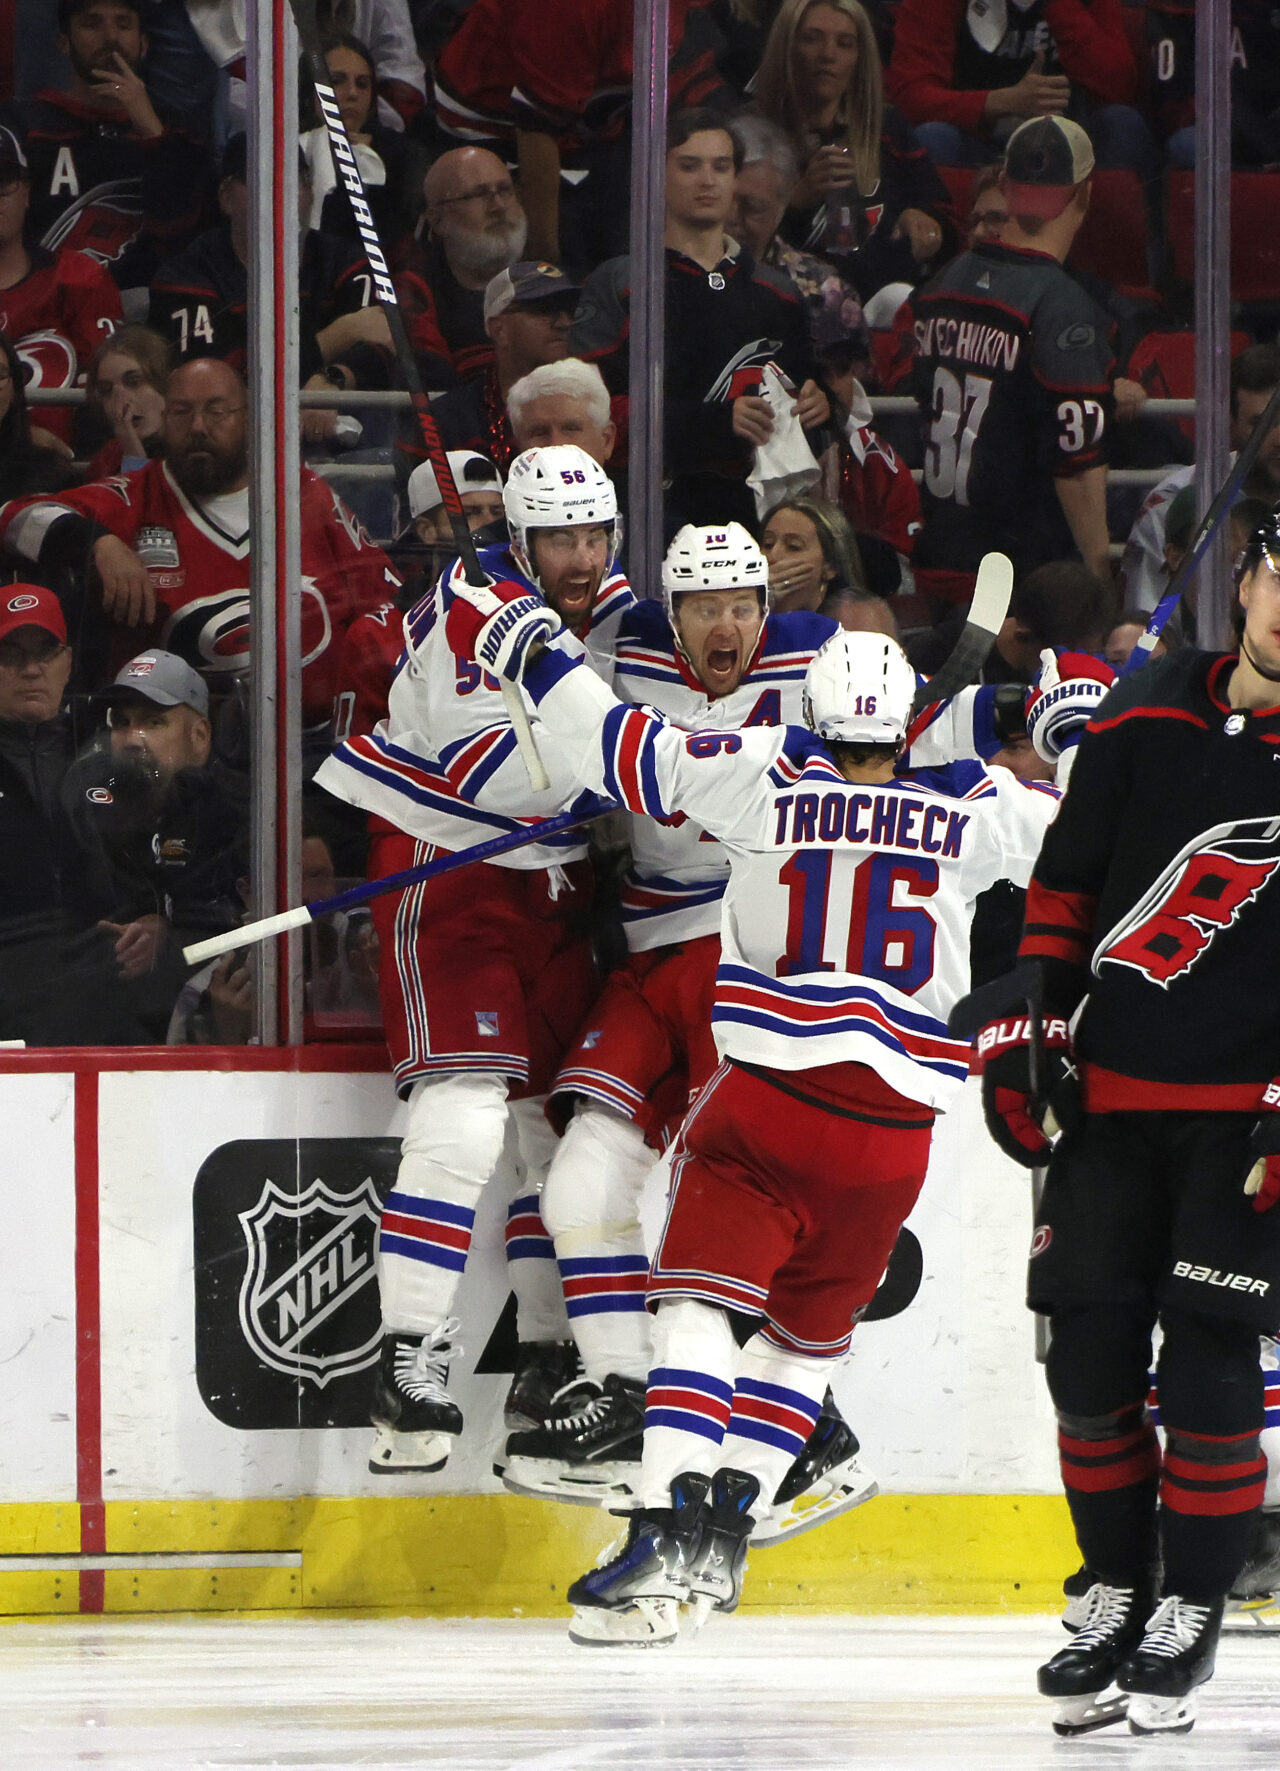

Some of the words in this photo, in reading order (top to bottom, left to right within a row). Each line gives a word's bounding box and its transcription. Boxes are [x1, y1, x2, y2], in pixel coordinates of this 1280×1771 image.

[50, 146, 80, 196] A
[314, 82, 398, 304] WARRIOR
[170, 304, 214, 353] 74
[924, 366, 994, 507] 37
[1057, 399, 1105, 453] 37
[417, 411, 465, 515] NOVIUM
[559, 470, 587, 486] 56
[562, 497, 596, 508] BAUER
[701, 559, 738, 569] CCM
[741, 689, 782, 728] A
[854, 695, 877, 716] 16
[774, 792, 971, 858] TROCHECK
[775, 848, 940, 997] 16
[976, 1018, 1069, 1058] AUER
[276, 1231, 369, 1340] NHL
[1172, 1260, 1271, 1298] BAUER
